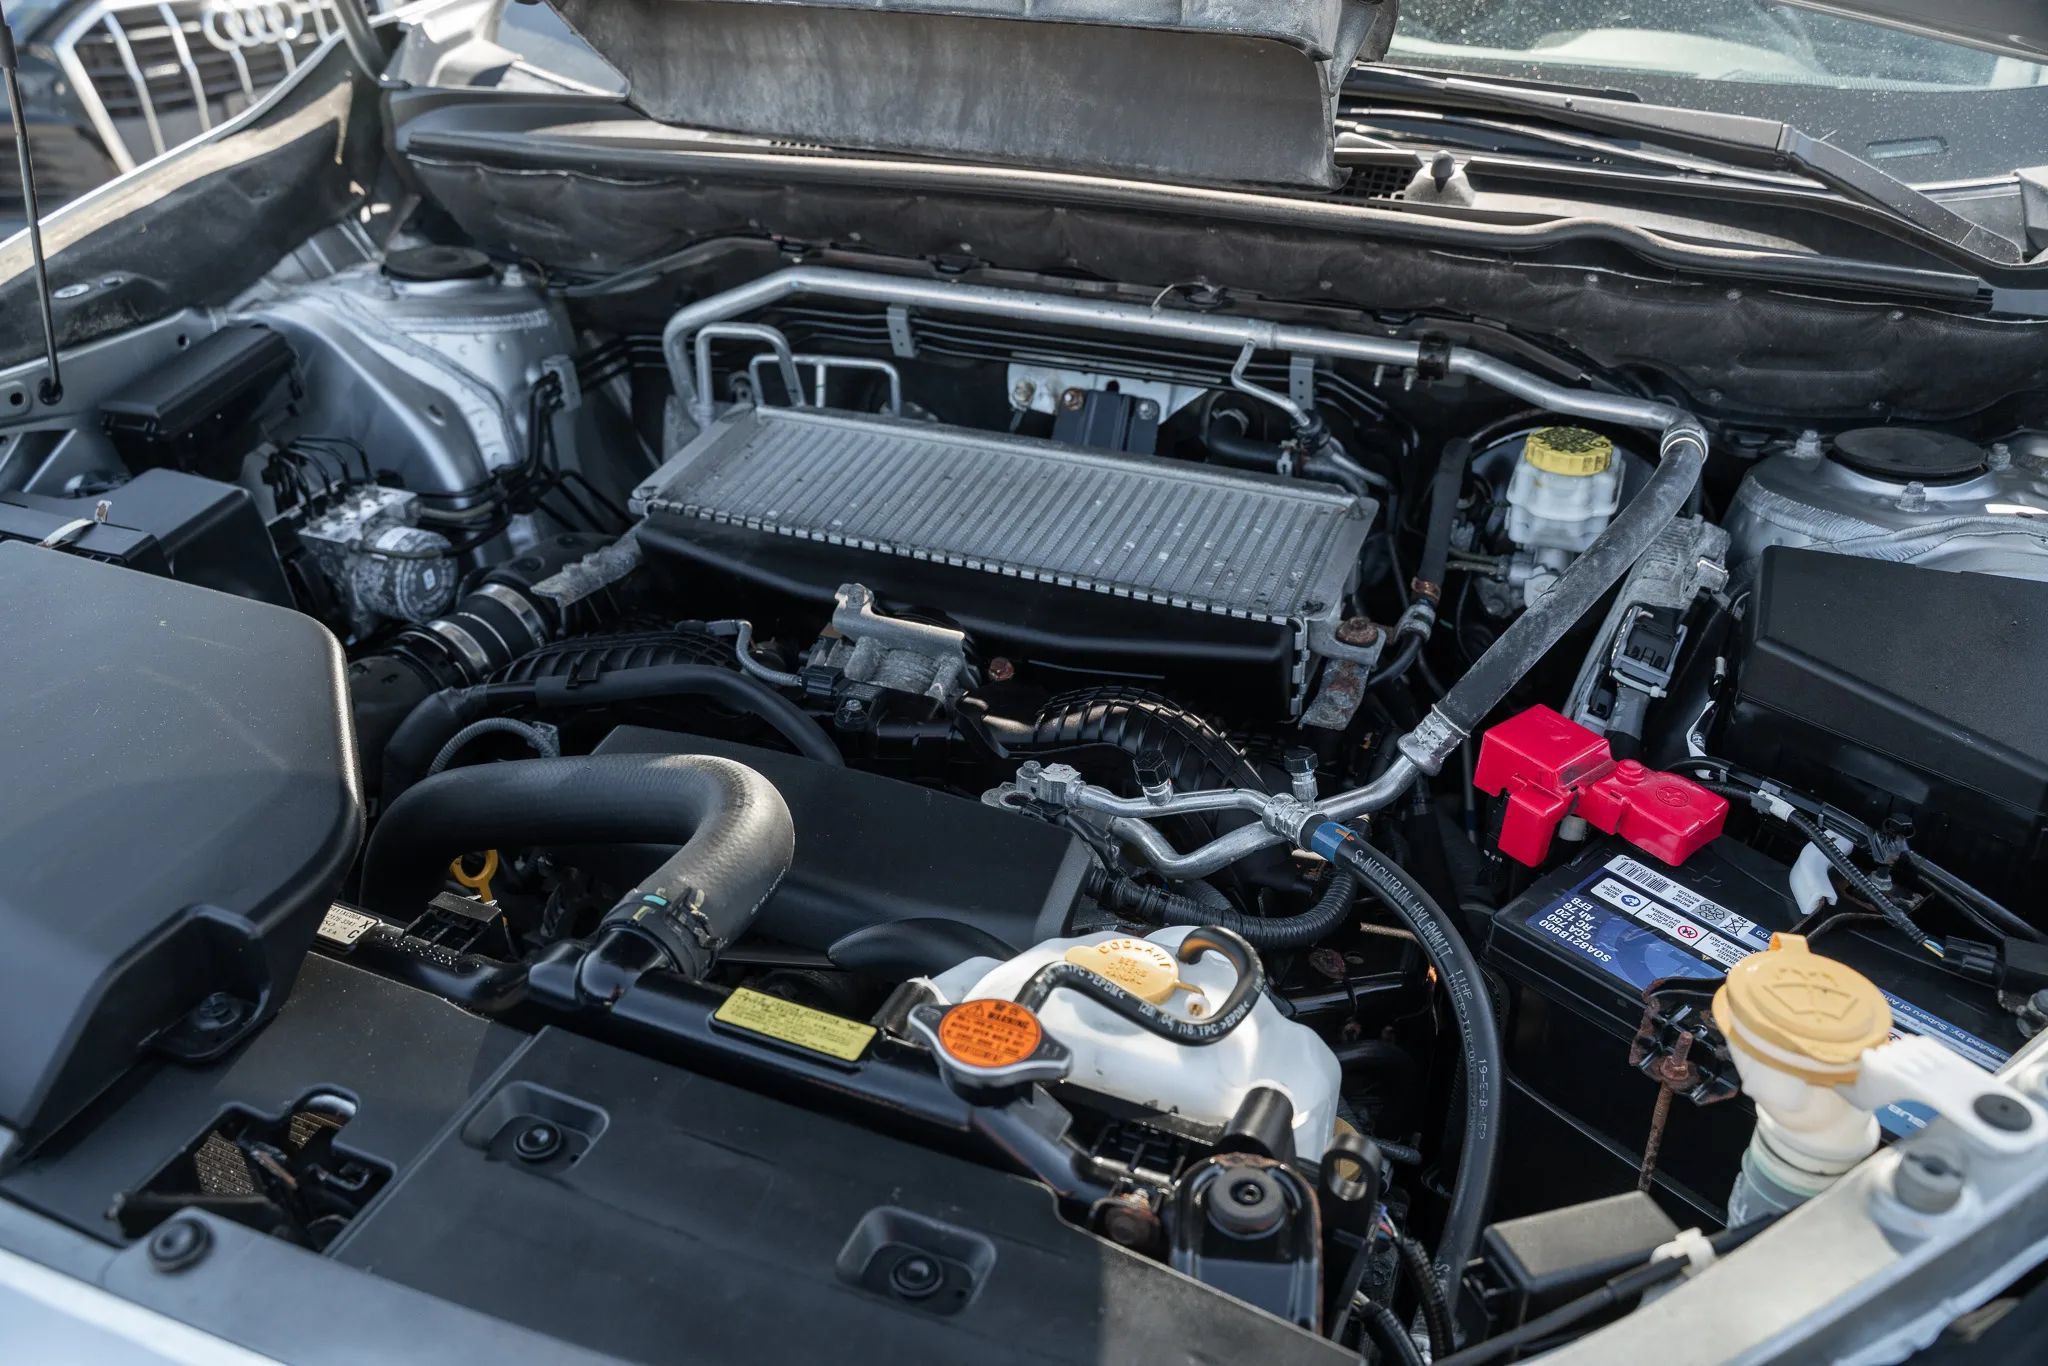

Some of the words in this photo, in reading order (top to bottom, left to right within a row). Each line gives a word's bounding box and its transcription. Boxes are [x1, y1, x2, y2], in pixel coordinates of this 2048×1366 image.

[1563, 903, 1578, 913] 76
[1571, 897, 1593, 911] EFB
[1547, 914, 1568, 927] 750
[1554, 908, 1575, 921] 120
[1579, 911, 1595, 921] Ah
[359, 920, 373, 930] X
[1575, 920, 1593, 931] RC
[346, 930, 360, 939] C
[1568, 925, 1591, 940] CCA
[1899, 1003, 1911, 1012] of
[1911, 1009, 1948, 1031] Subaru
[1197, 1023, 1219, 1036] TPC
